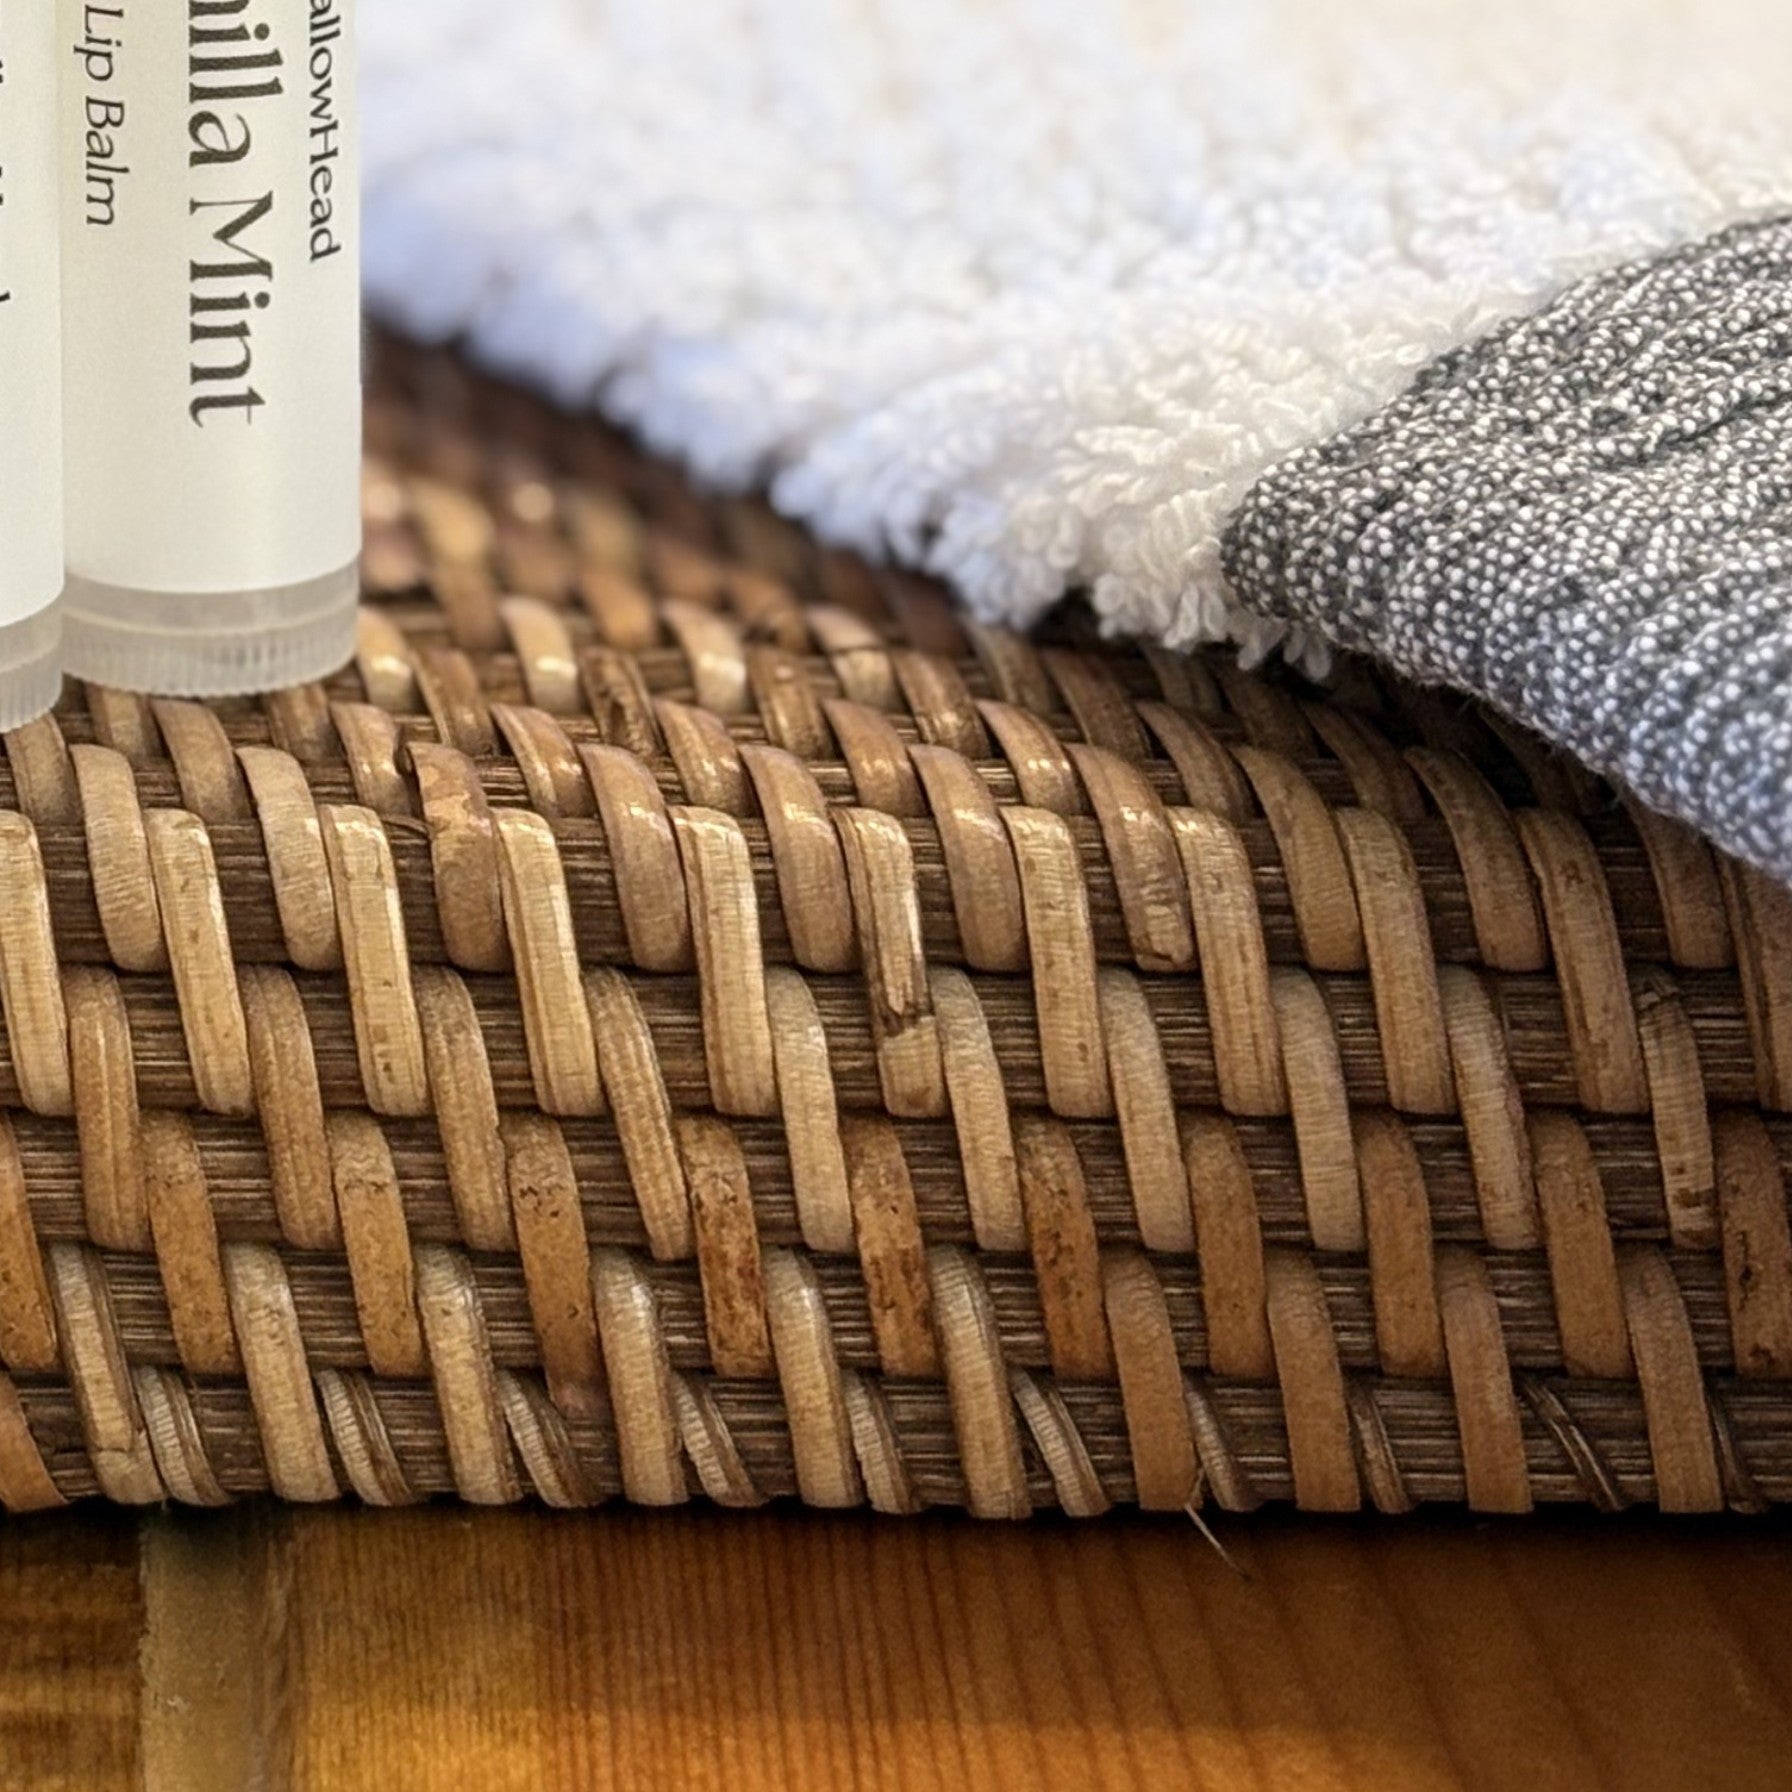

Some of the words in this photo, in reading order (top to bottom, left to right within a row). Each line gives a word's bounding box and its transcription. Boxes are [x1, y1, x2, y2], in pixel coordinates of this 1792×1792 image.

[72, 3, 125, 83] Lip
[84, 94, 131, 227] Balm
[188, 189, 274, 428] Mint
